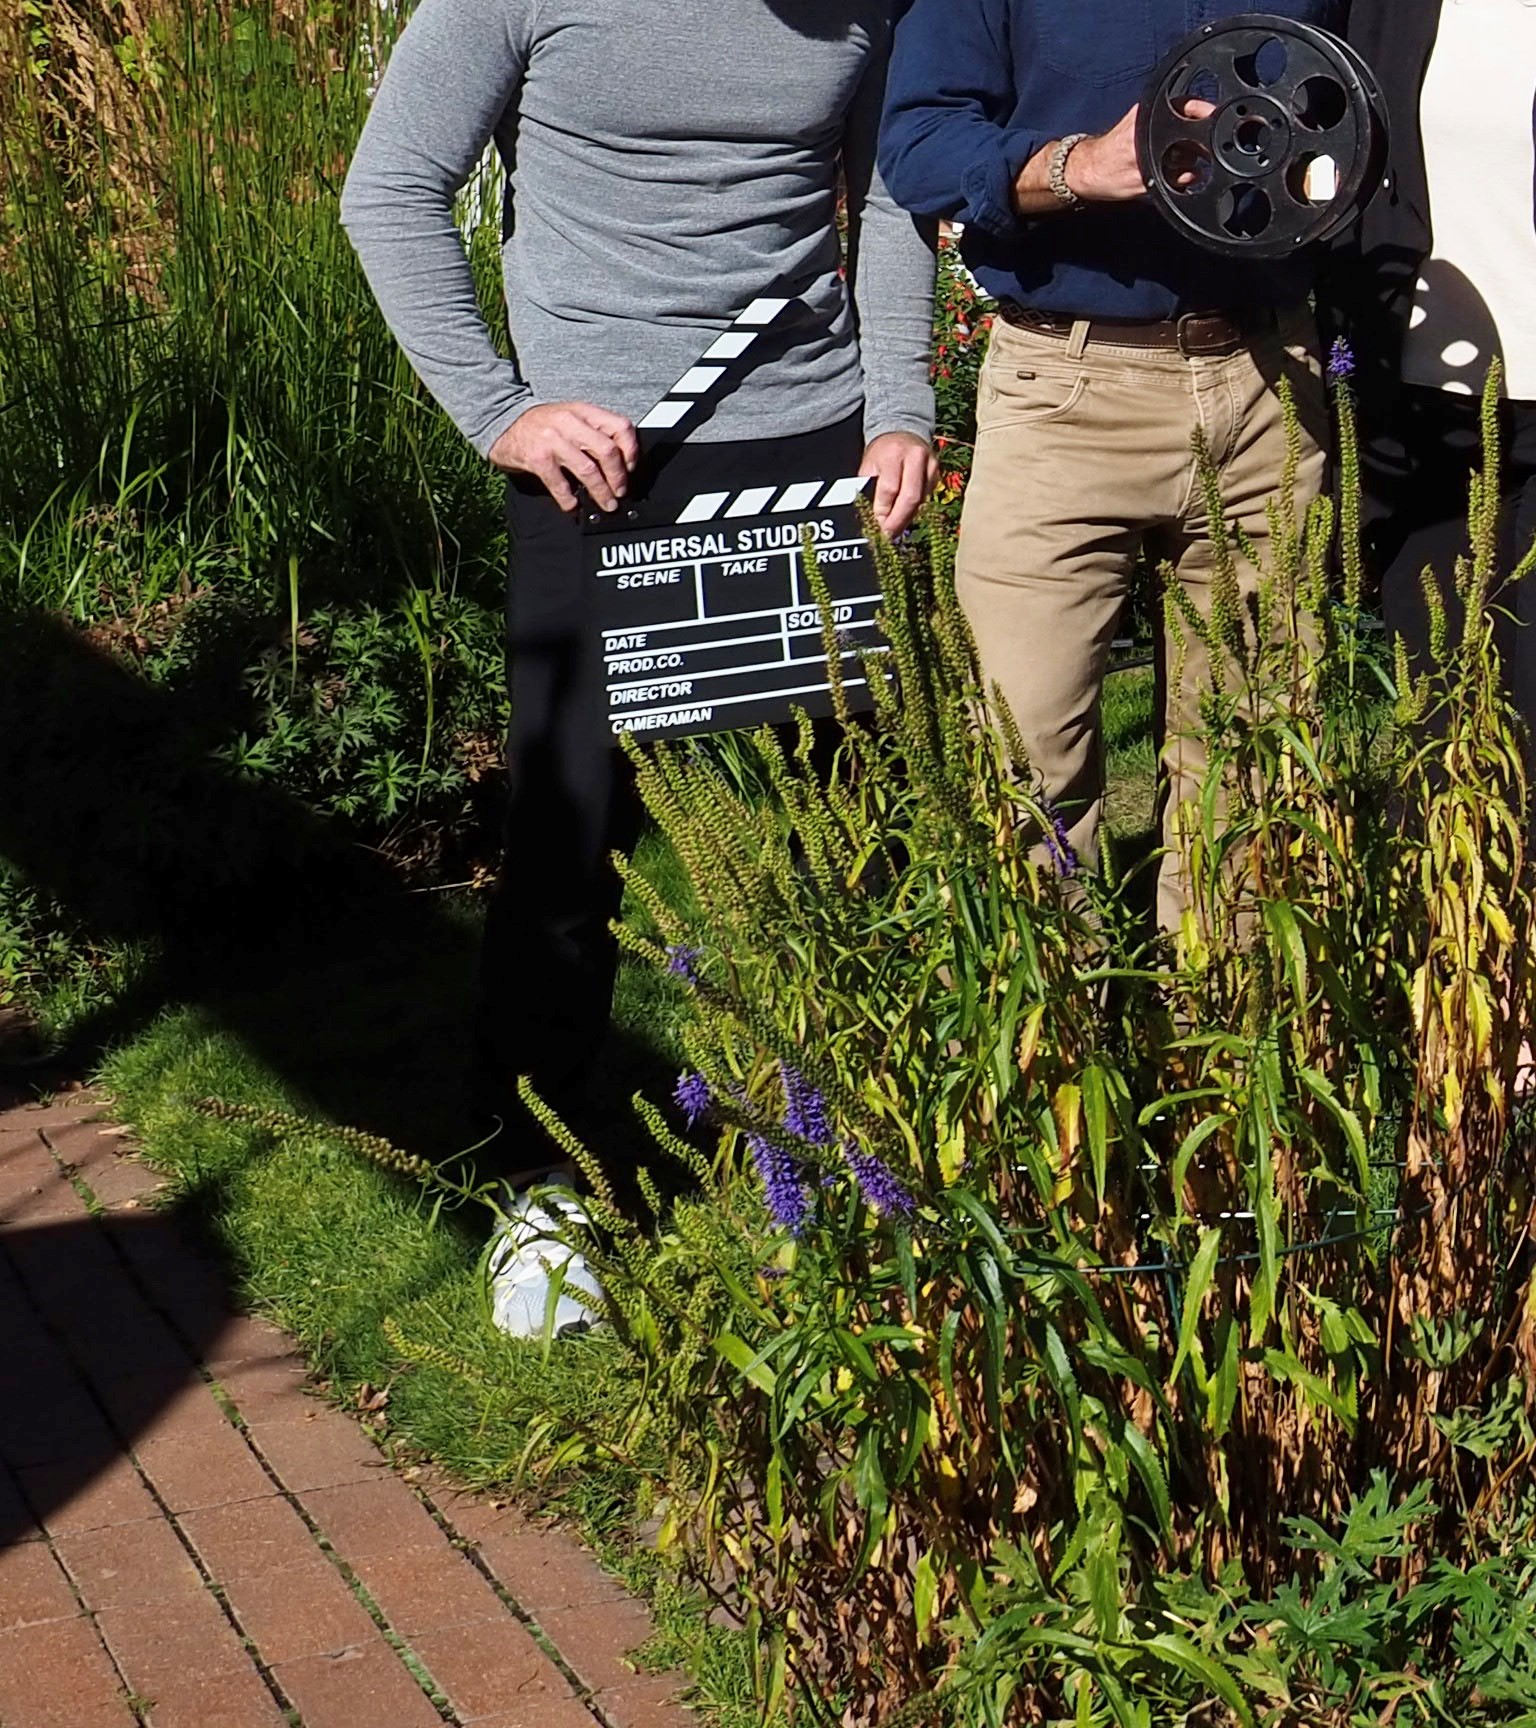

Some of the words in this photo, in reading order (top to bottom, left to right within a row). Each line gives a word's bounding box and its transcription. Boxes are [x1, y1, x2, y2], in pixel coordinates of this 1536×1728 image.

[601, 533, 732, 567] UNIVERSAL
[737, 519, 835, 552] STUDIOS
[616, 569, 681, 590] SCENE
[721, 558, 768, 576] TAKE
[816, 547, 863, 564] ROLL
[604, 634, 647, 652] DATE
[607, 654, 684, 675] PROD.CO.
[609, 681, 692, 705] DIRECTOR
[611, 707, 712, 734] CAMERAMAN
